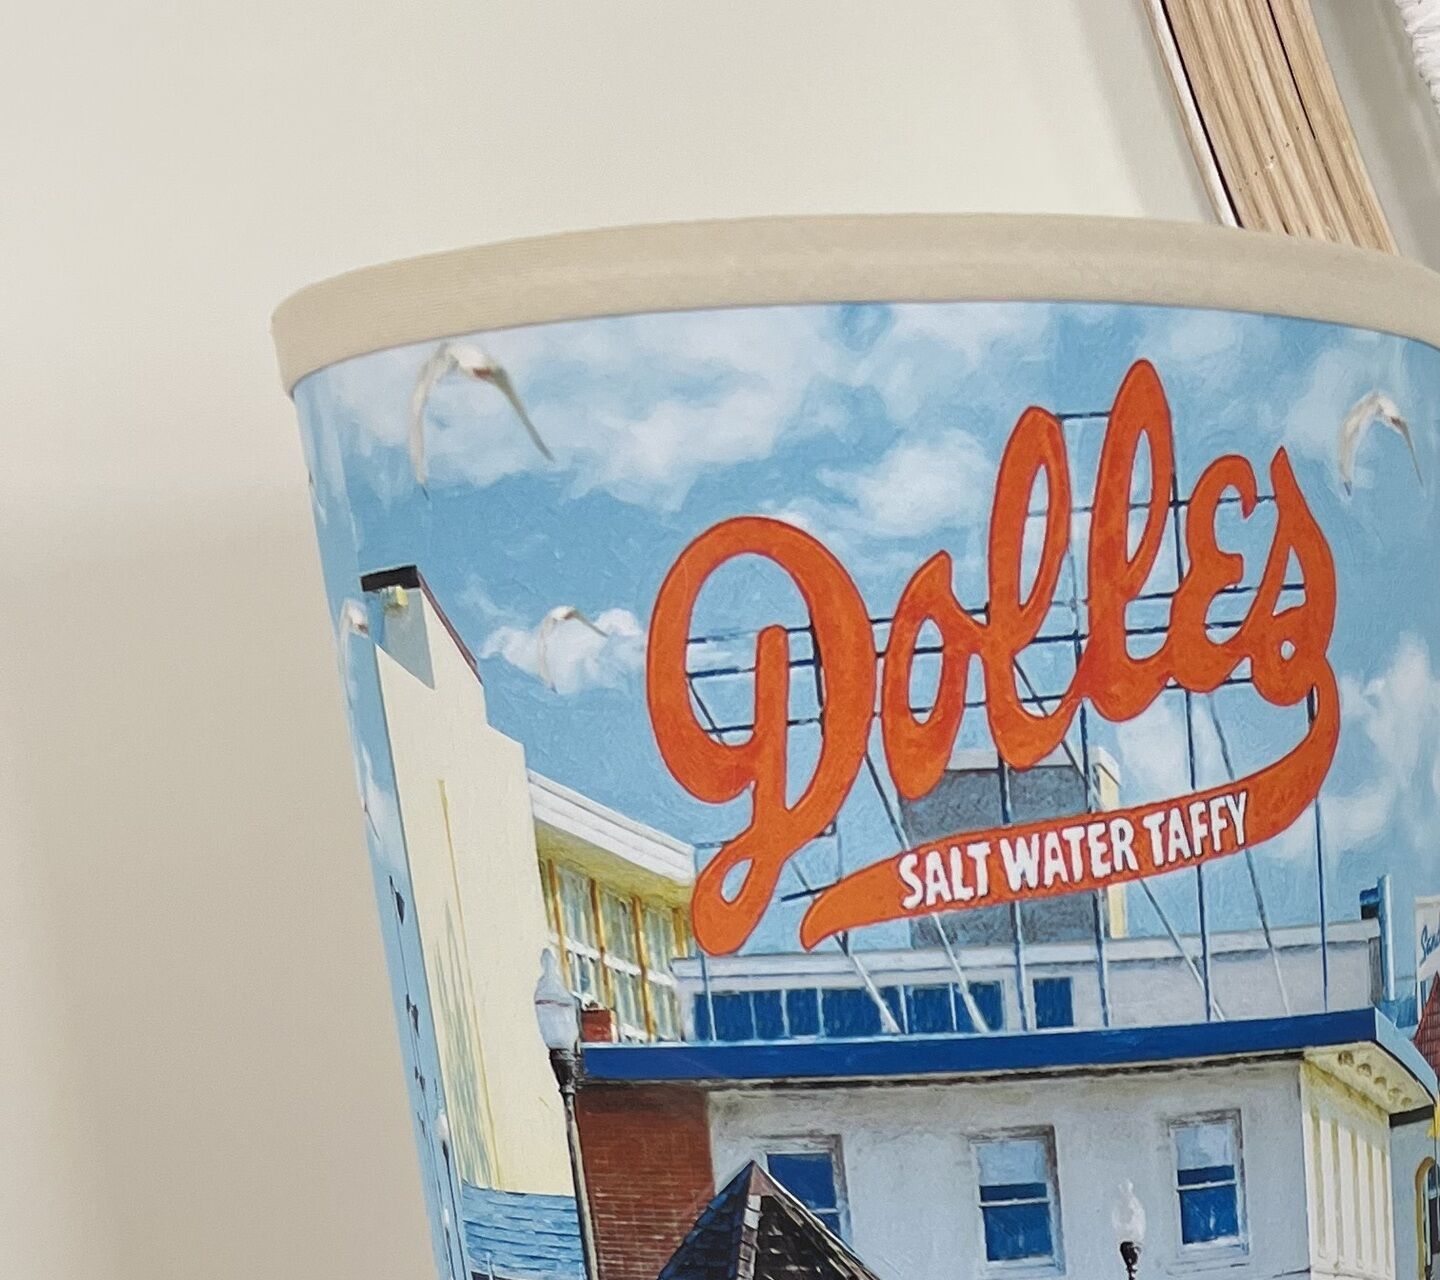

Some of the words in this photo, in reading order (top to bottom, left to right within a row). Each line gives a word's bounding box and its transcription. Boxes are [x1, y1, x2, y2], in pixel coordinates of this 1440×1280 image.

[899, 841, 991, 910] SALT
[1001, 817, 1139, 892] WATER
[1143, 790, 1248, 867] TAFFY
